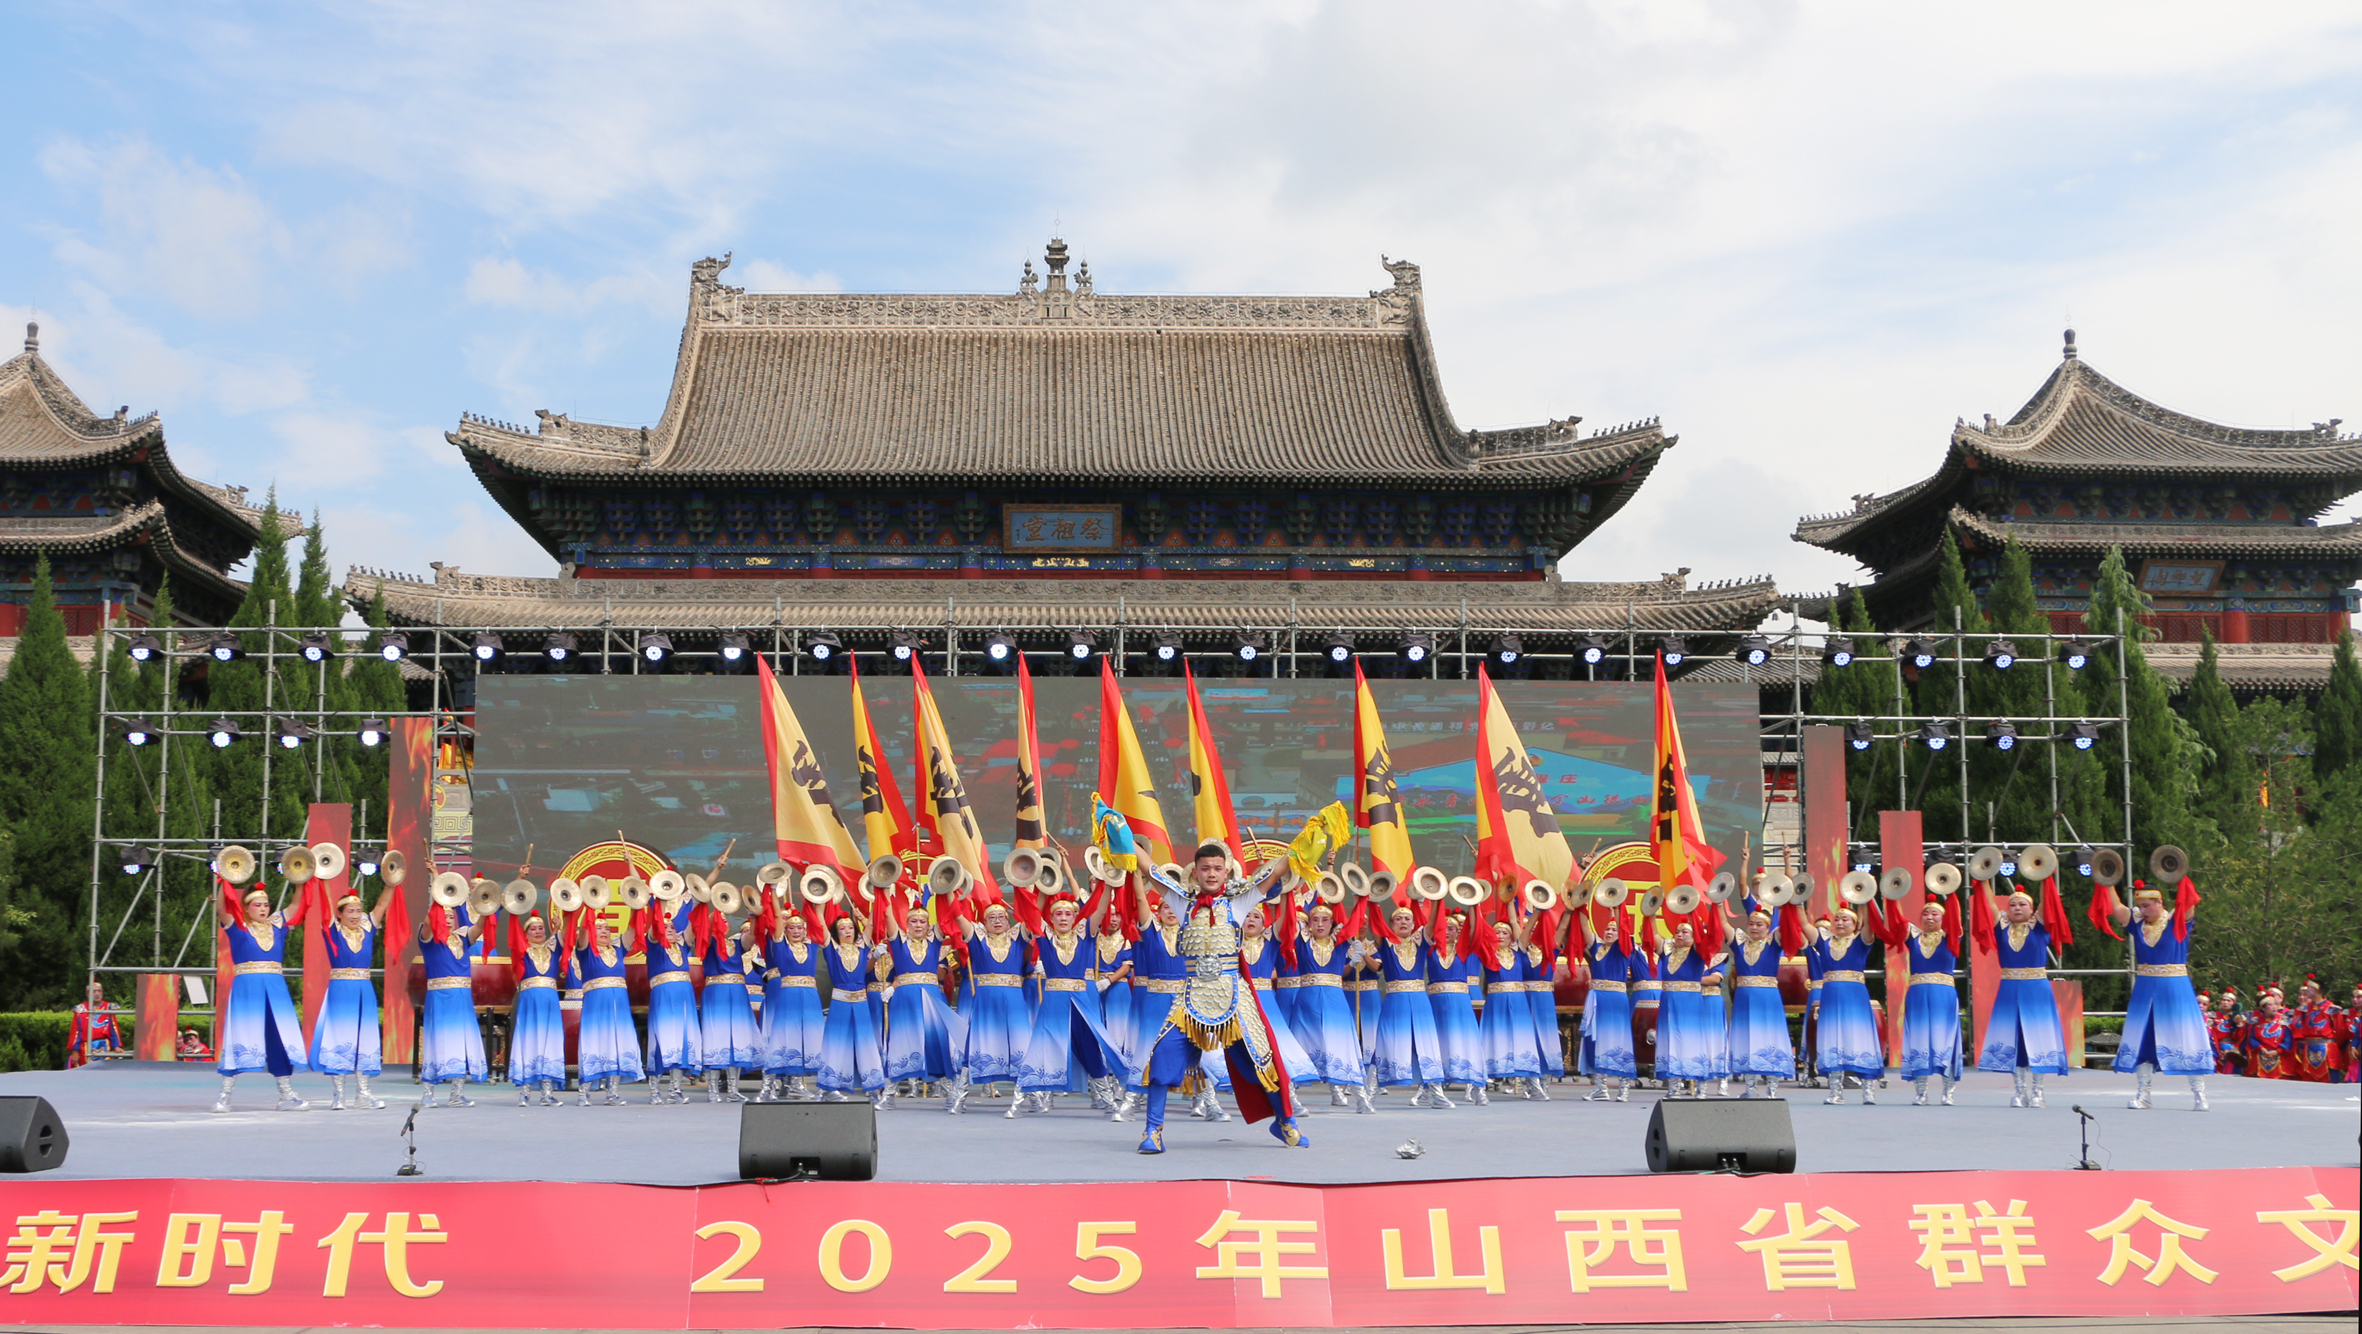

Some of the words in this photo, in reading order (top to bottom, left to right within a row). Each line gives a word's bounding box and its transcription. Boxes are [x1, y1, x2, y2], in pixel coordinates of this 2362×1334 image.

[1022, 515, 1108, 541] 祭祖堂
[0, 1209, 448, 1298] 新时代
